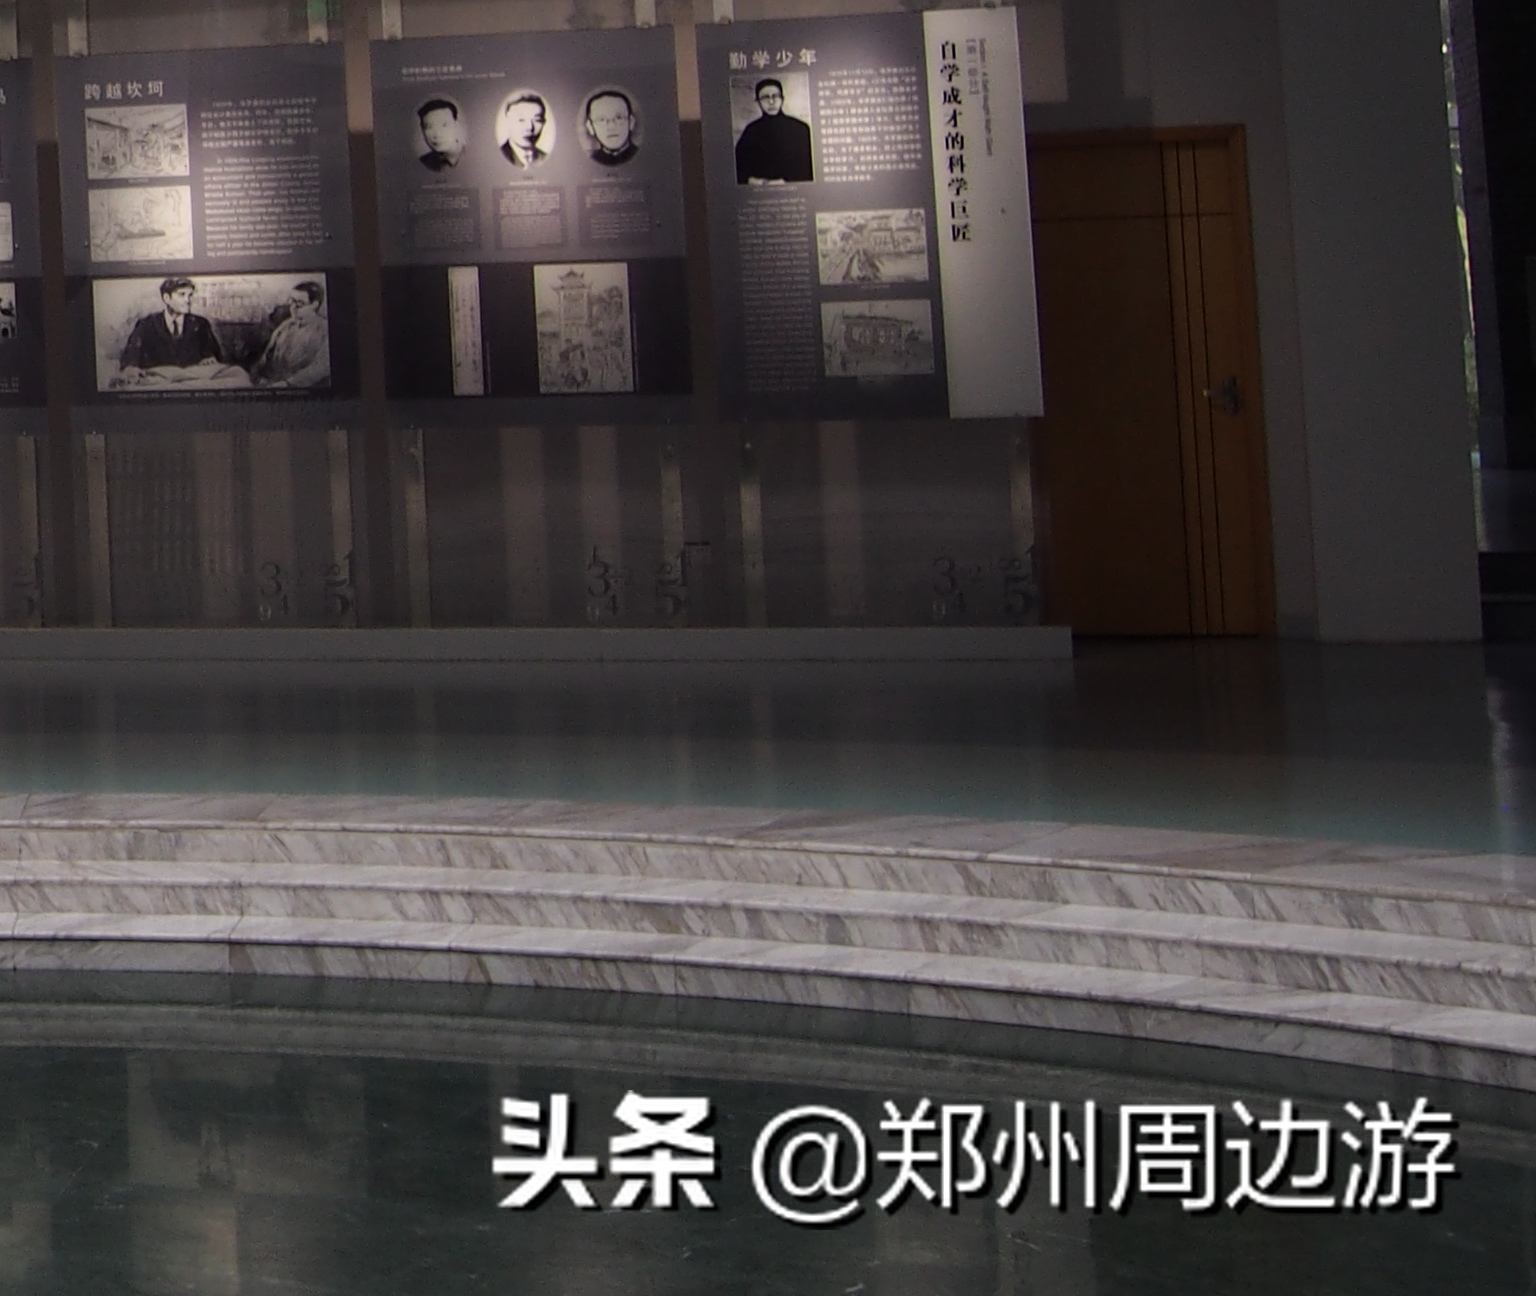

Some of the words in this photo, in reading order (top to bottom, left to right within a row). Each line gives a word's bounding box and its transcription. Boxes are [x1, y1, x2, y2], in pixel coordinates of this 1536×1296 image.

[728, 47, 817, 70] 勤学少年
[84, 80, 164, 101] 跨越坎坷
[939, 40, 972, 242] 自学成才的科学巨匠
